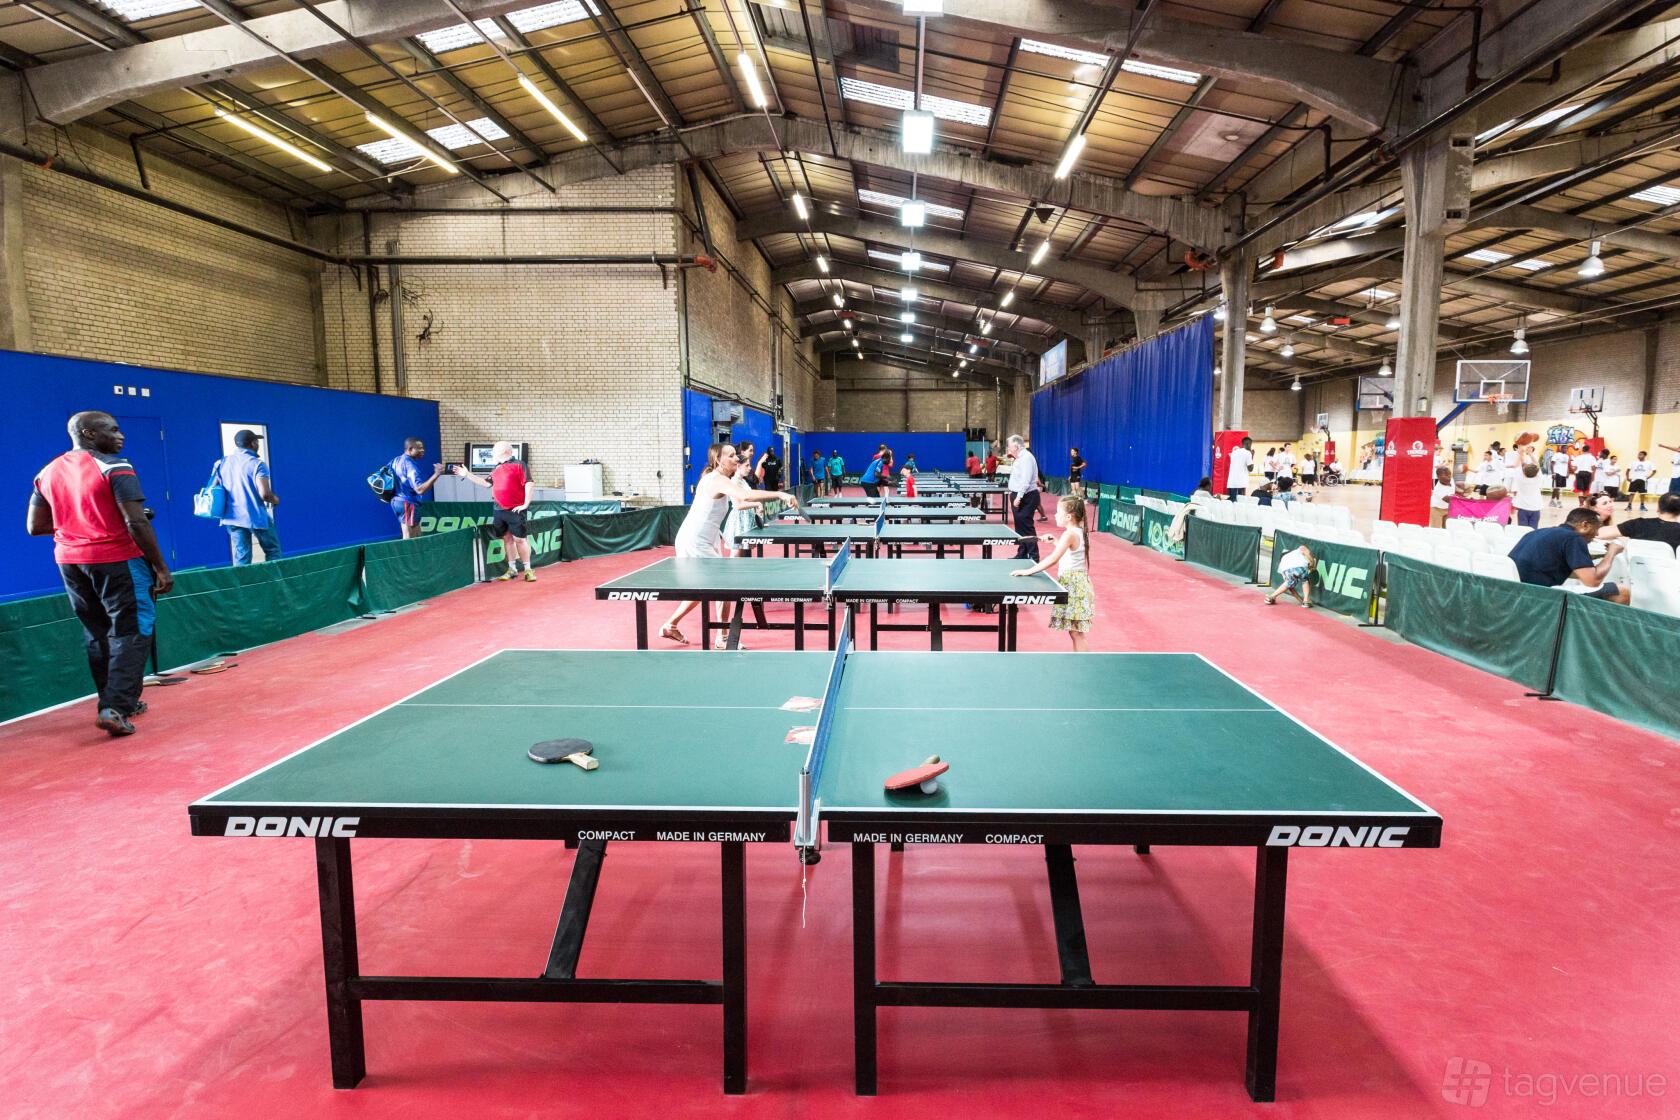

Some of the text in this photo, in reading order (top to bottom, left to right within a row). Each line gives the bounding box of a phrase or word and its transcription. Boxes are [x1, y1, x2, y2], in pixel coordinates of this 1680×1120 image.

[1110, 509, 1140, 533] DONIC
[486, 528, 562, 565] DNIC
[1316, 559, 1368, 600] NIC
[607, 591, 660, 602] DONIC
[1001, 595, 1057, 605] DONIC
[223, 816, 361, 838] DONIC
[577, 830, 766, 843] COMPACT MADE IN GERMANY
[1265, 825, 1411, 848] DONIC
[853, 832, 1045, 845] MADE IN GERMANY COMPACT
